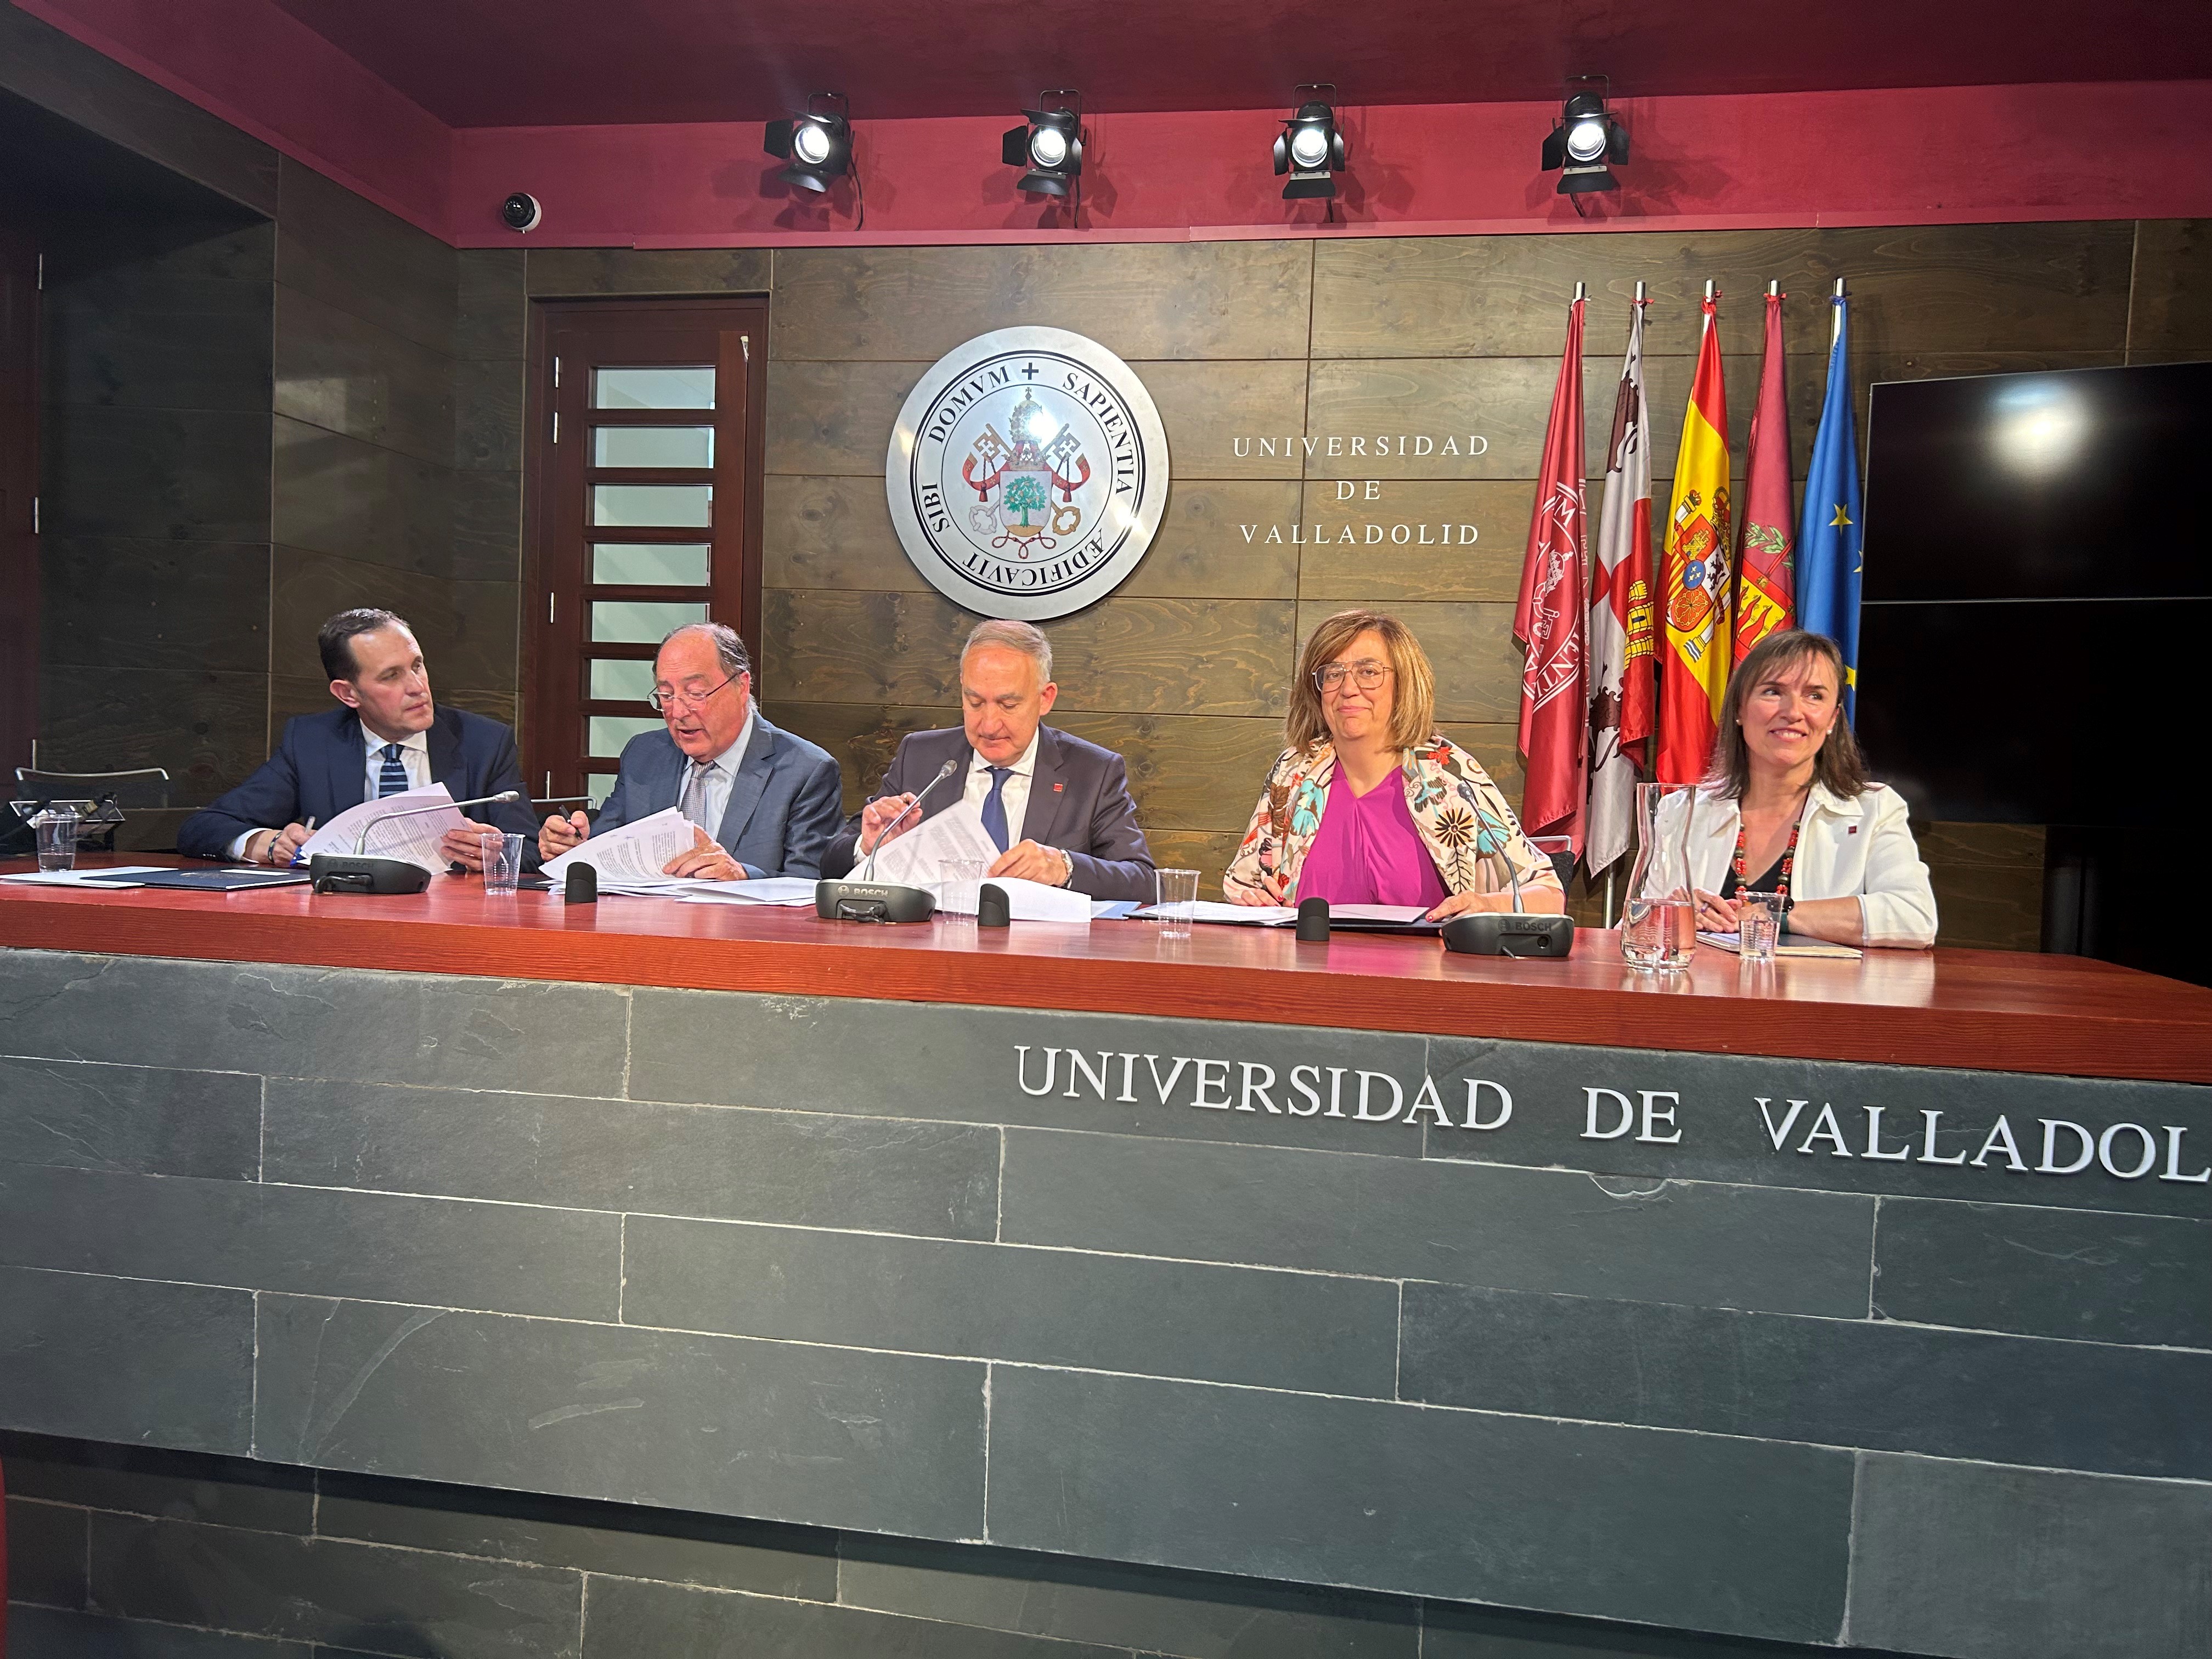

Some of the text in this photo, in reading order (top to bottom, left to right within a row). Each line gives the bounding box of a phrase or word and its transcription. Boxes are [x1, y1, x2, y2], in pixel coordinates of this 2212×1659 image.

[928, 365, 1011, 444] DOMVM
[1062, 372, 1135, 494] SAPIENTIA
[1233, 436, 1488, 457] UNIVERSIDAD
[1336, 481, 1380, 500] DE
[922, 482, 951, 533] SIBI
[1239, 524, 1479, 544] VALLADOLID
[854, 888, 888, 897] BOSCH
[1515, 922, 1552, 932] BOSCH
[1014, 1045, 2211, 1183] UNIVERSIDAD DE VALLADOL
